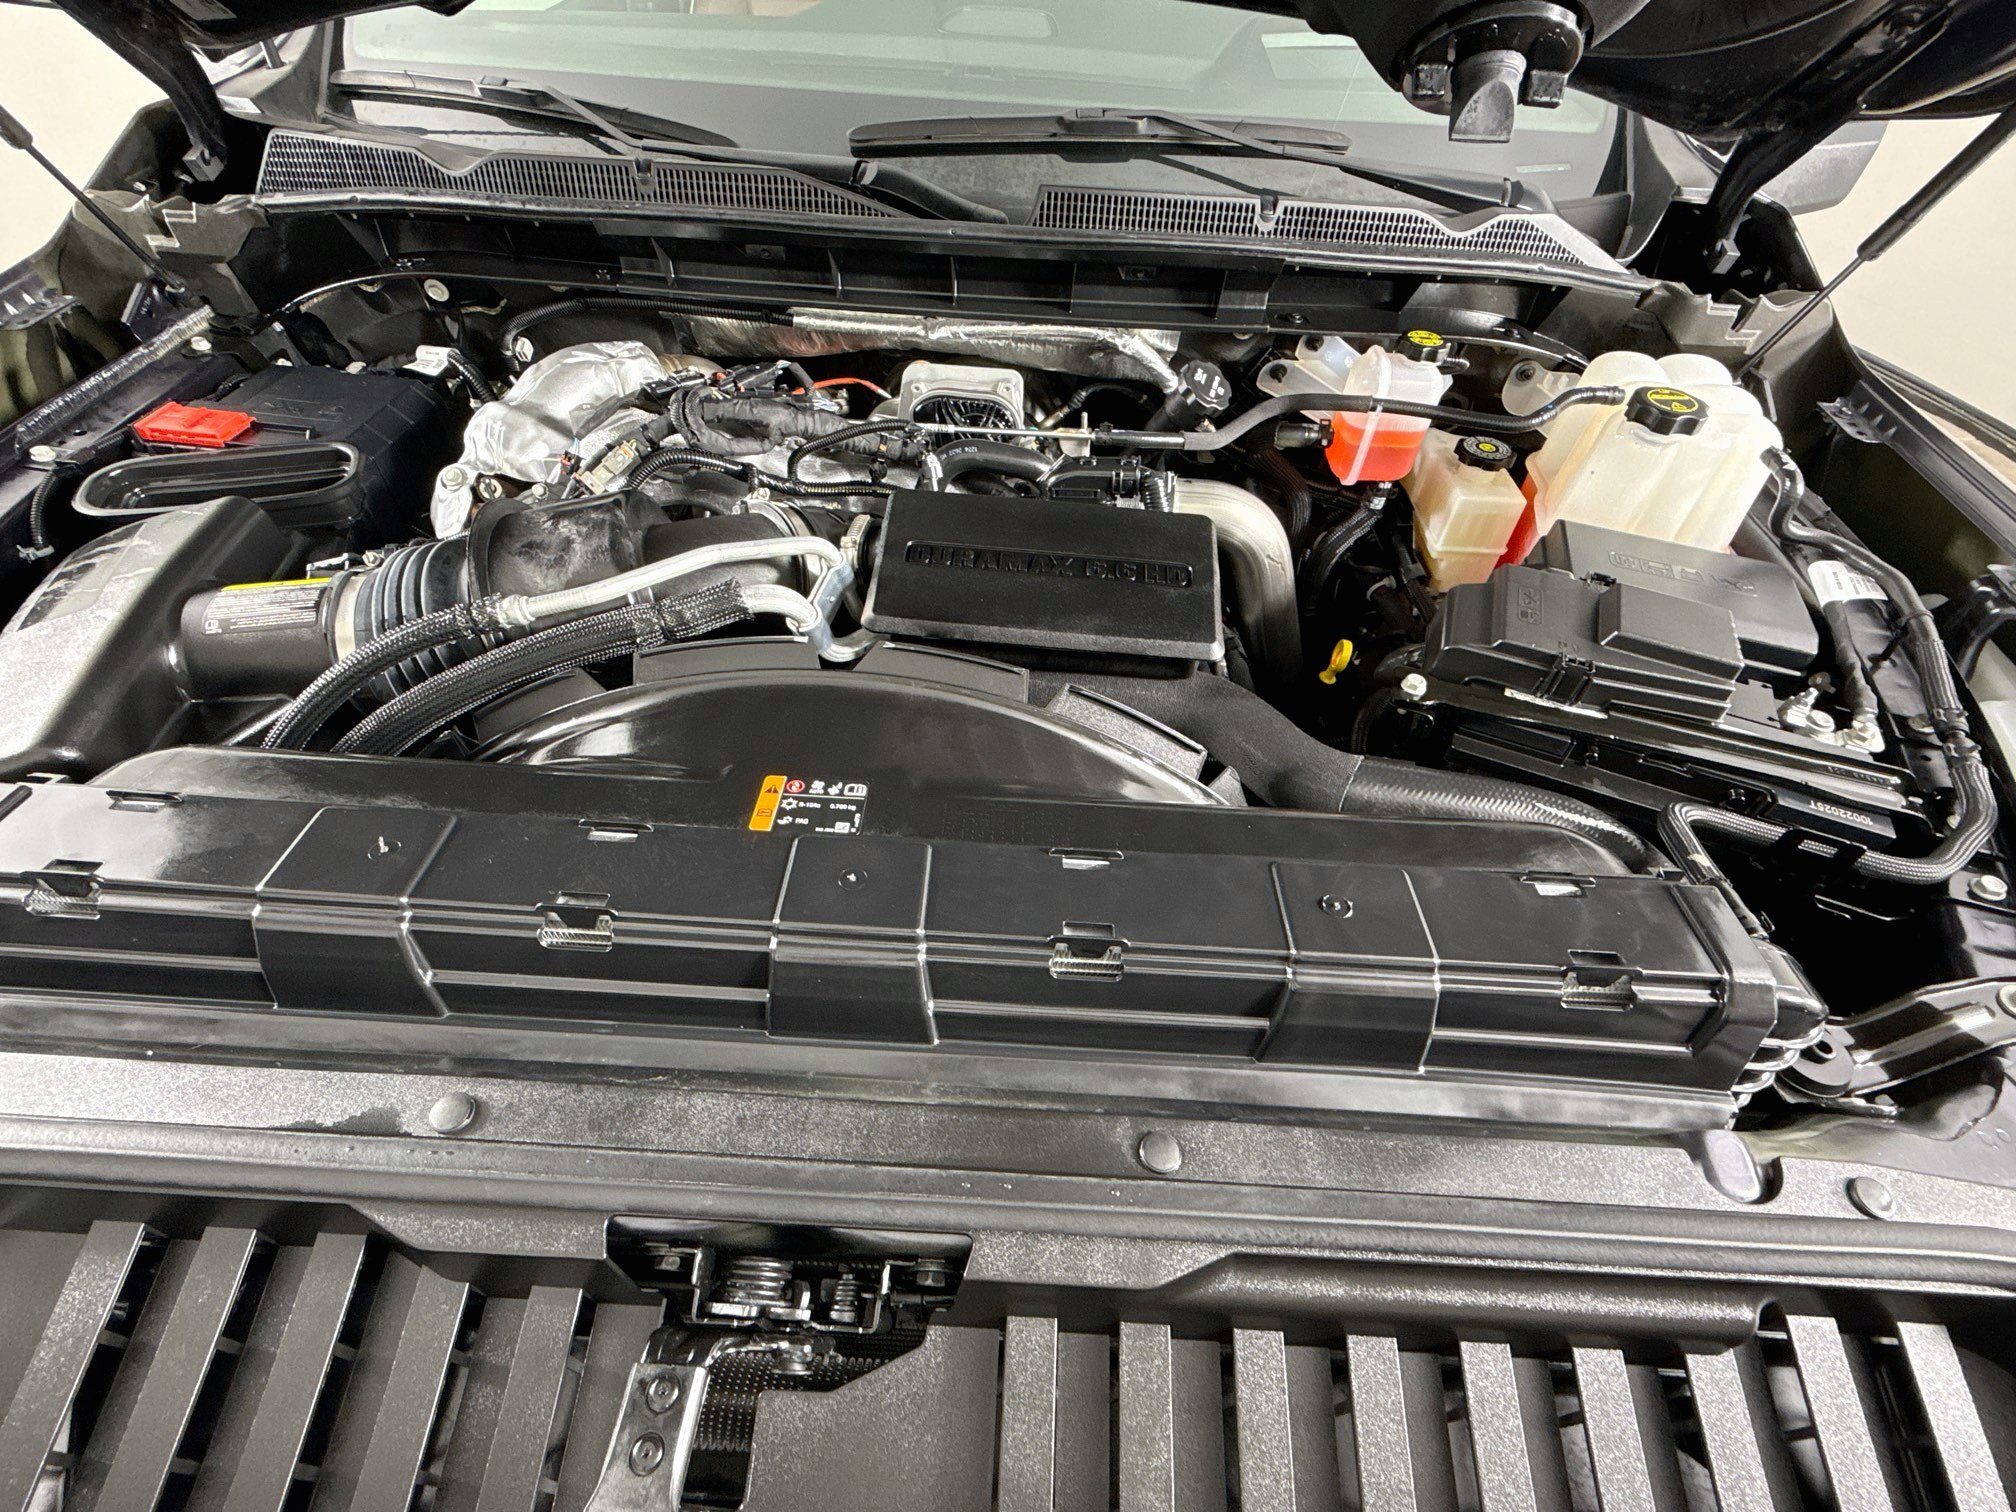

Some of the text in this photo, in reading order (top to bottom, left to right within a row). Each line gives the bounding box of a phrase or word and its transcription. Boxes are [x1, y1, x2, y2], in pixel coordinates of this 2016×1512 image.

[907, 544, 1192, 587] DURAMAX 6.6 HD
[1808, 800, 1874, 826] 10022025T
